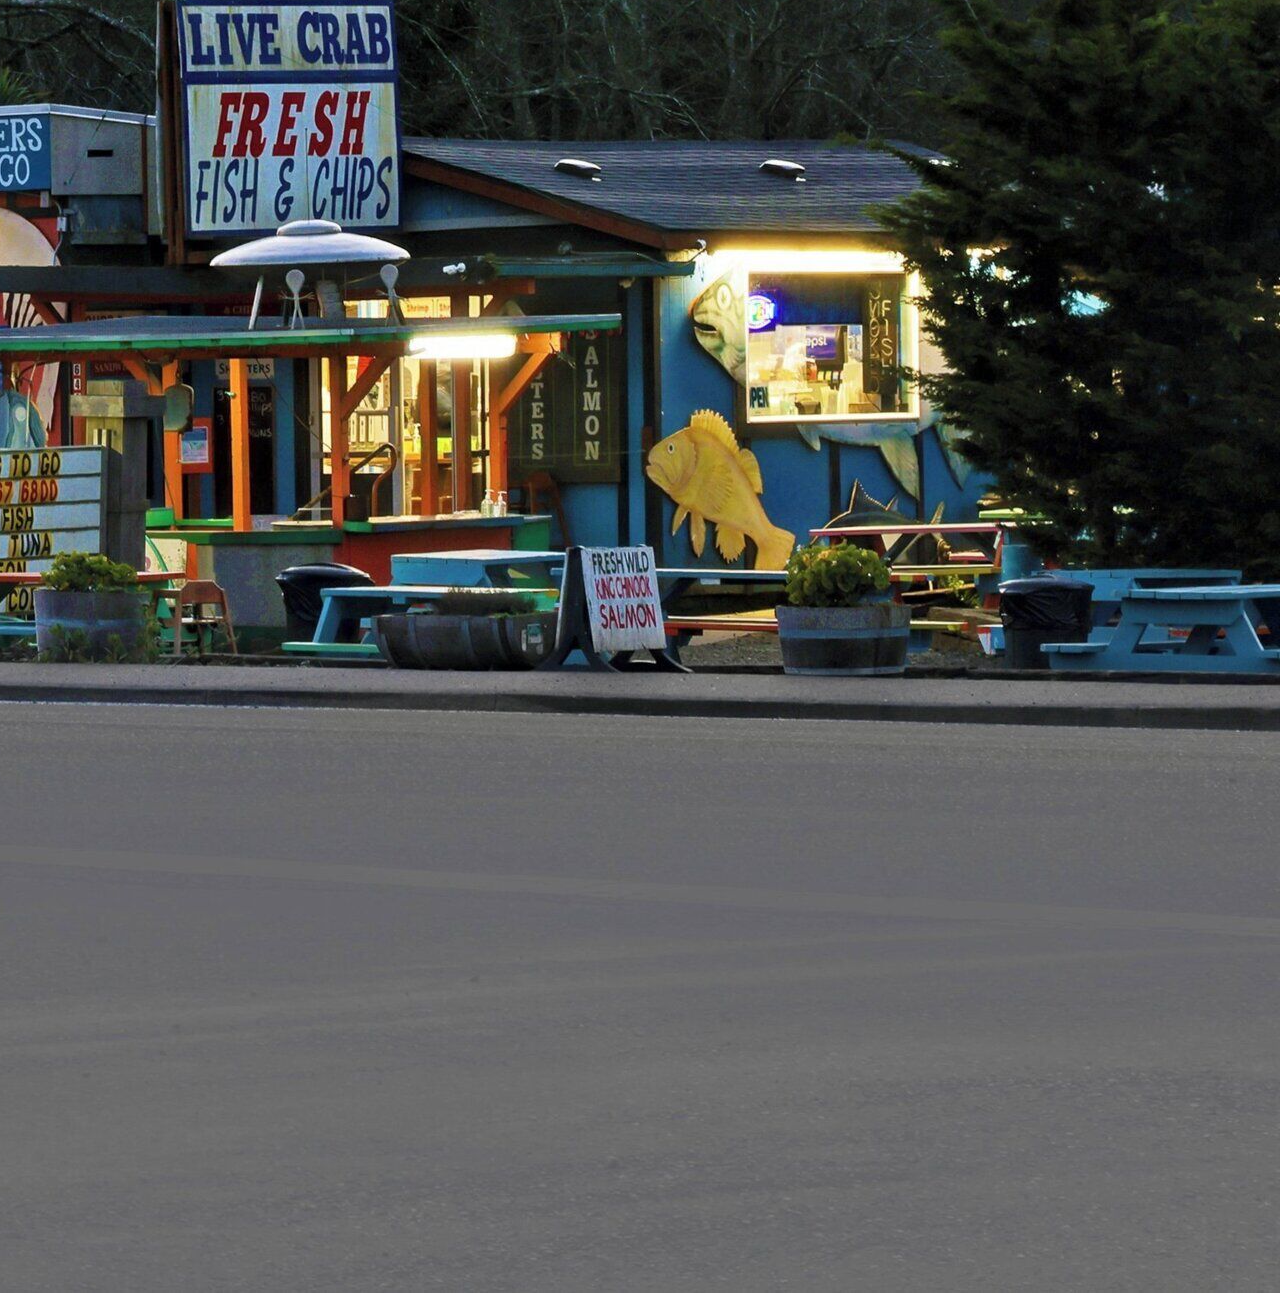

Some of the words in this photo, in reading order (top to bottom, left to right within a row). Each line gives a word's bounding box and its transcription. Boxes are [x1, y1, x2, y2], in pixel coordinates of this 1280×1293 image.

[188, 13, 281, 65] LIVE
[297, 11, 390, 64] CRAB
[212, 90, 371, 158] FRESH
[195, 159, 259, 224] FISH
[274, 158, 295, 222] &
[312, 156, 393, 221] CHIPS
[806, 335, 827, 351] epsi
[219, 363, 271, 375] SHTERS
[750, 387, 769, 408] PEN
[531, 372, 545, 460] TERS
[11, 453, 31, 477] TO
[40, 451, 61, 476] GO
[21, 479, 58, 503] 6800
[2, 507, 34, 531] FISH
[11, 533, 51, 557] TUNA
[591, 551, 624, 575] FRESH
[624, 551, 649, 573] WILD
[615, 575, 653, 599] CHINOOK
[599, 603, 657, 629] SALMON
